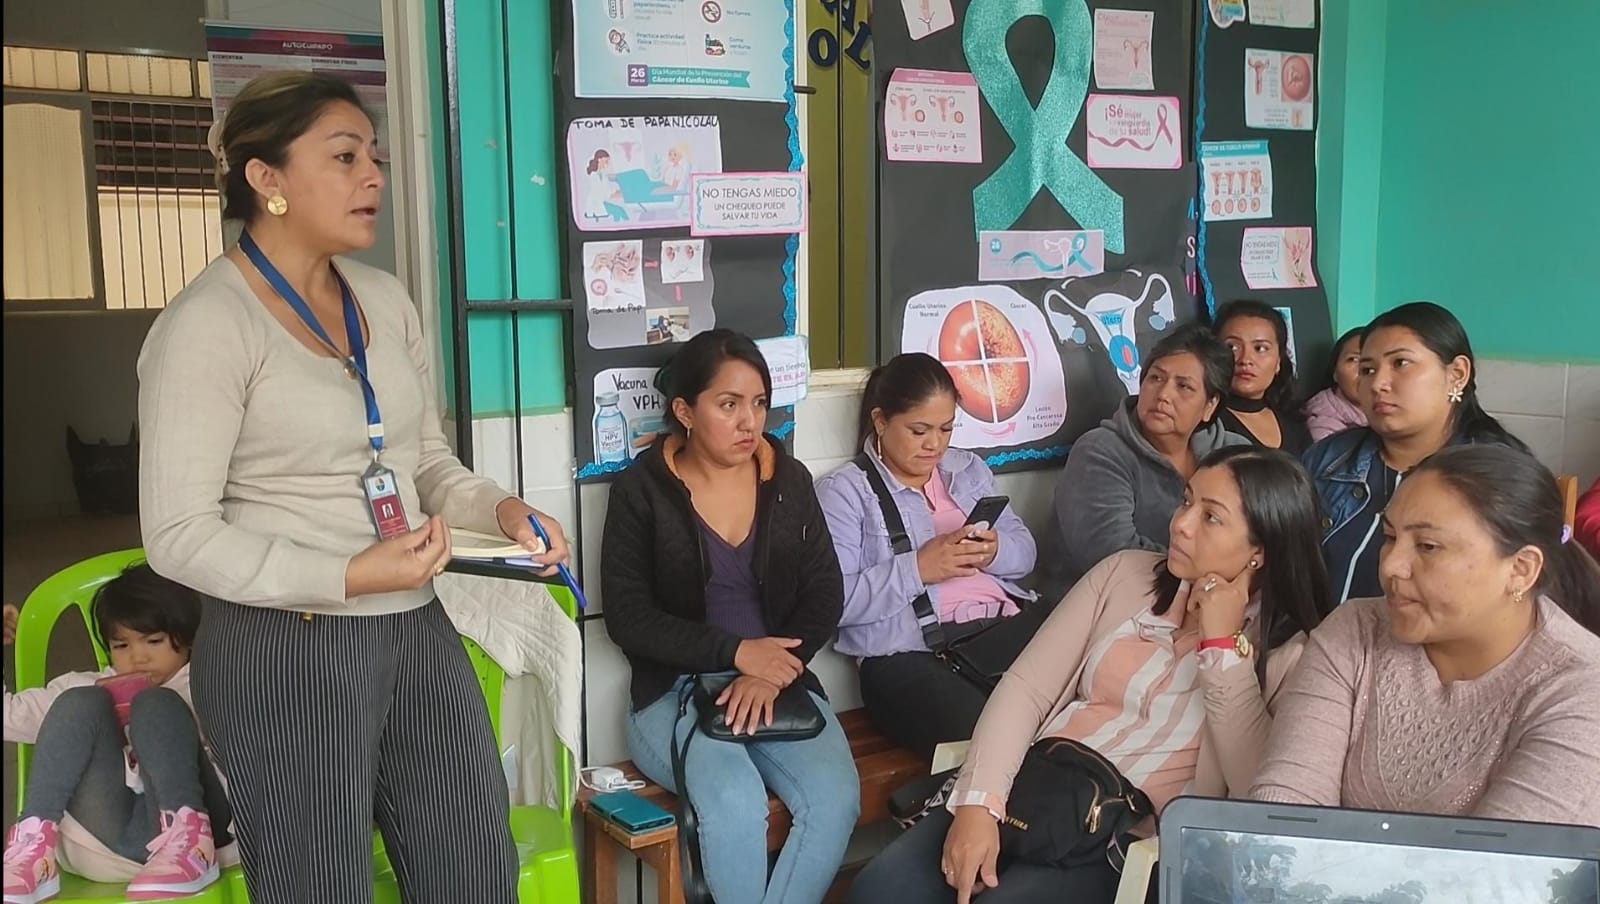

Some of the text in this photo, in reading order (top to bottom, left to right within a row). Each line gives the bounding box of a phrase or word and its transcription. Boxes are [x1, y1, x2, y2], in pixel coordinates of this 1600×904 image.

[630, 68, 645, 78] 26
[573, 115, 718, 129] TOMA DE PAPANICOLAU
[702, 186, 797, 198] NO TENGAS MIEDO
[714, 201, 786, 211] UN CHEQUEO PUEDE
[722, 211, 778, 220] SALVAR TU VIDA
[616, 304, 627, 313] de
[611, 373, 648, 391] Vacuna
[633, 394, 661, 411] VPH
